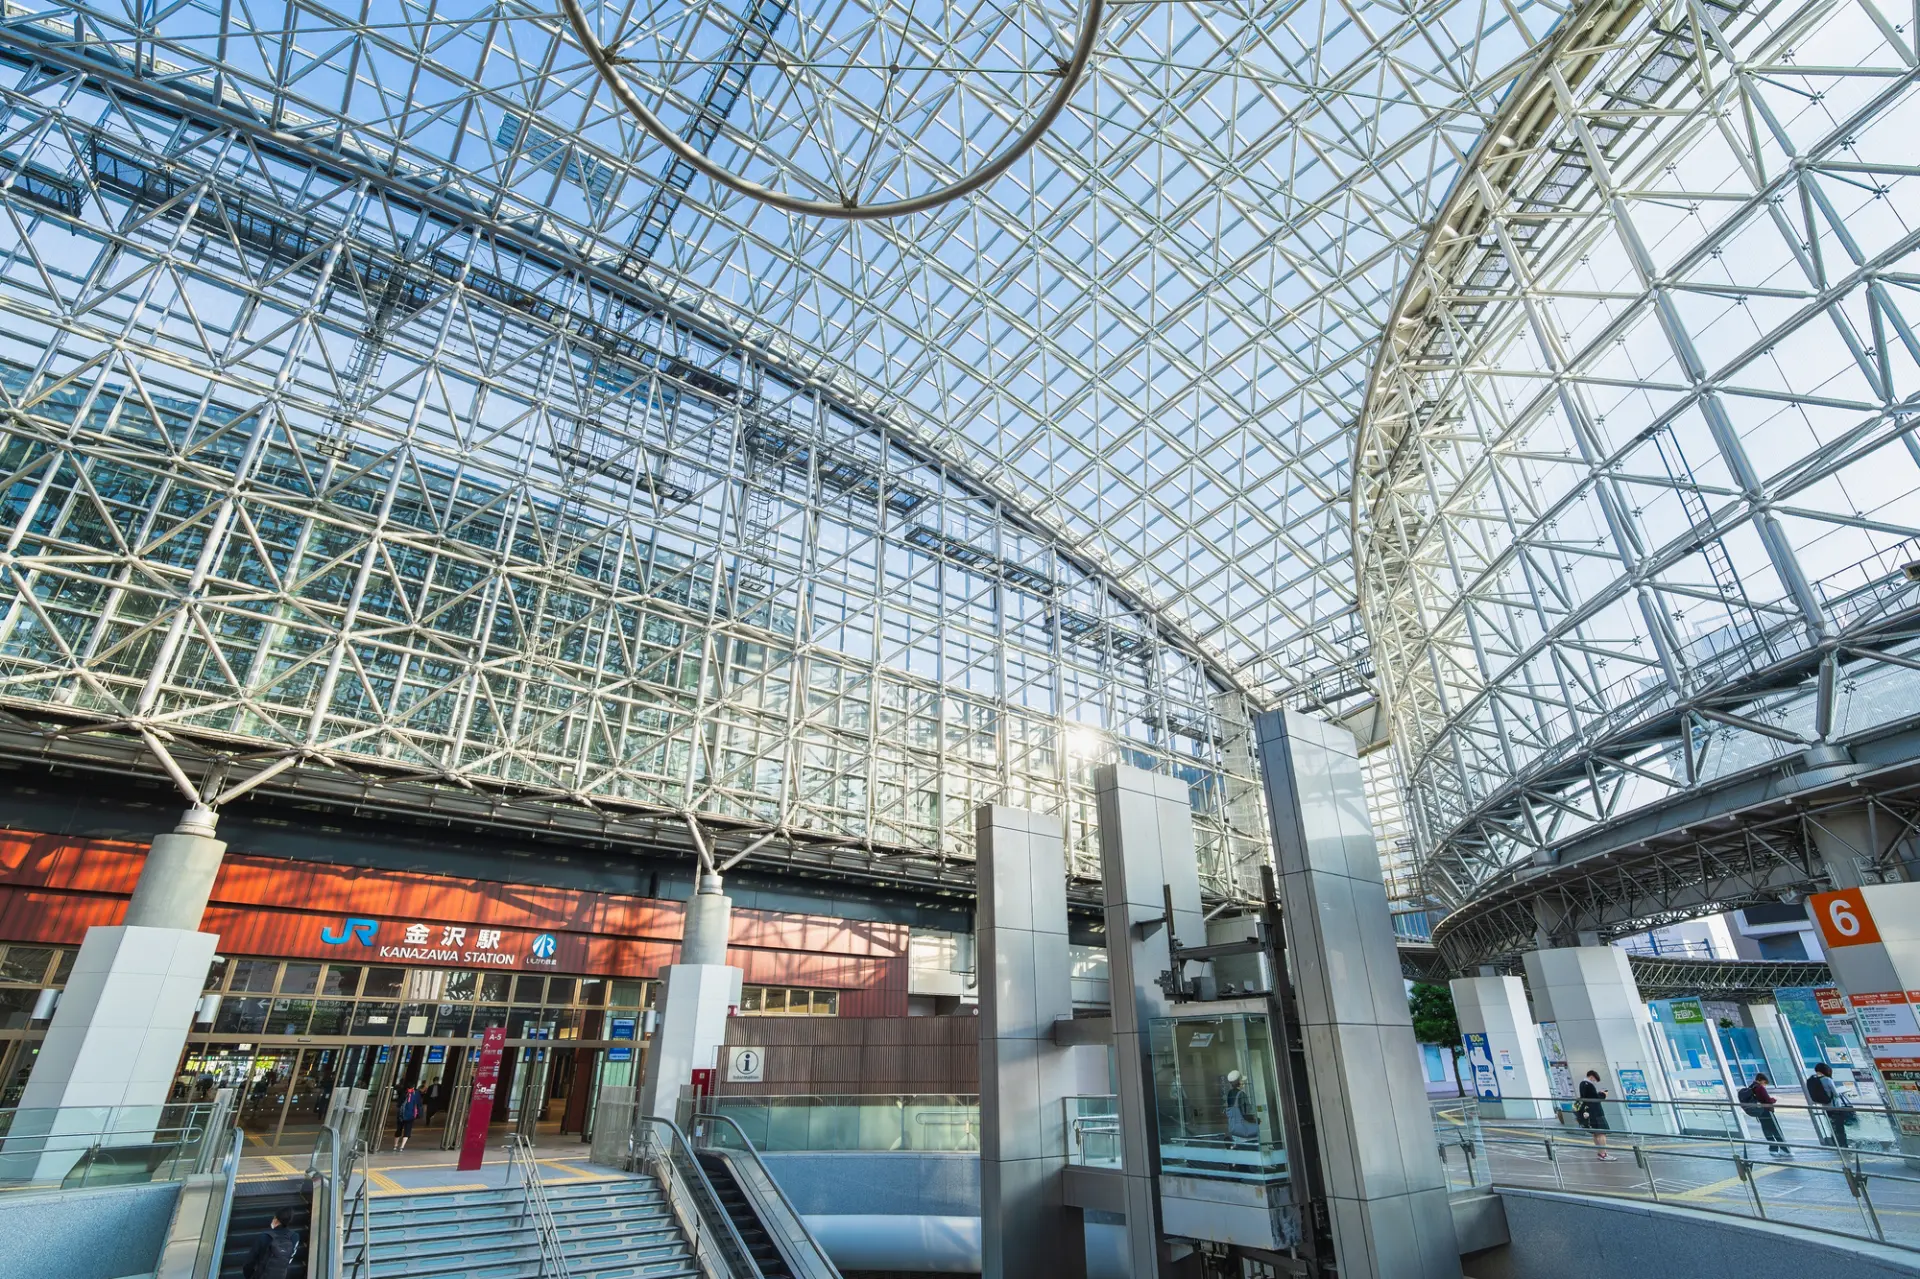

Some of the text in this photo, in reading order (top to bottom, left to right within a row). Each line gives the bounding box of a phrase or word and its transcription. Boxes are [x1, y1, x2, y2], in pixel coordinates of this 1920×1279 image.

[1829, 899, 1860, 937] 6
[320, 918, 379, 946] JR
[403, 923, 501, 949] 金沢駅
[380, 946, 515, 965] KANAZAWA STATION
[1651, 1006, 1659, 1019] 4
